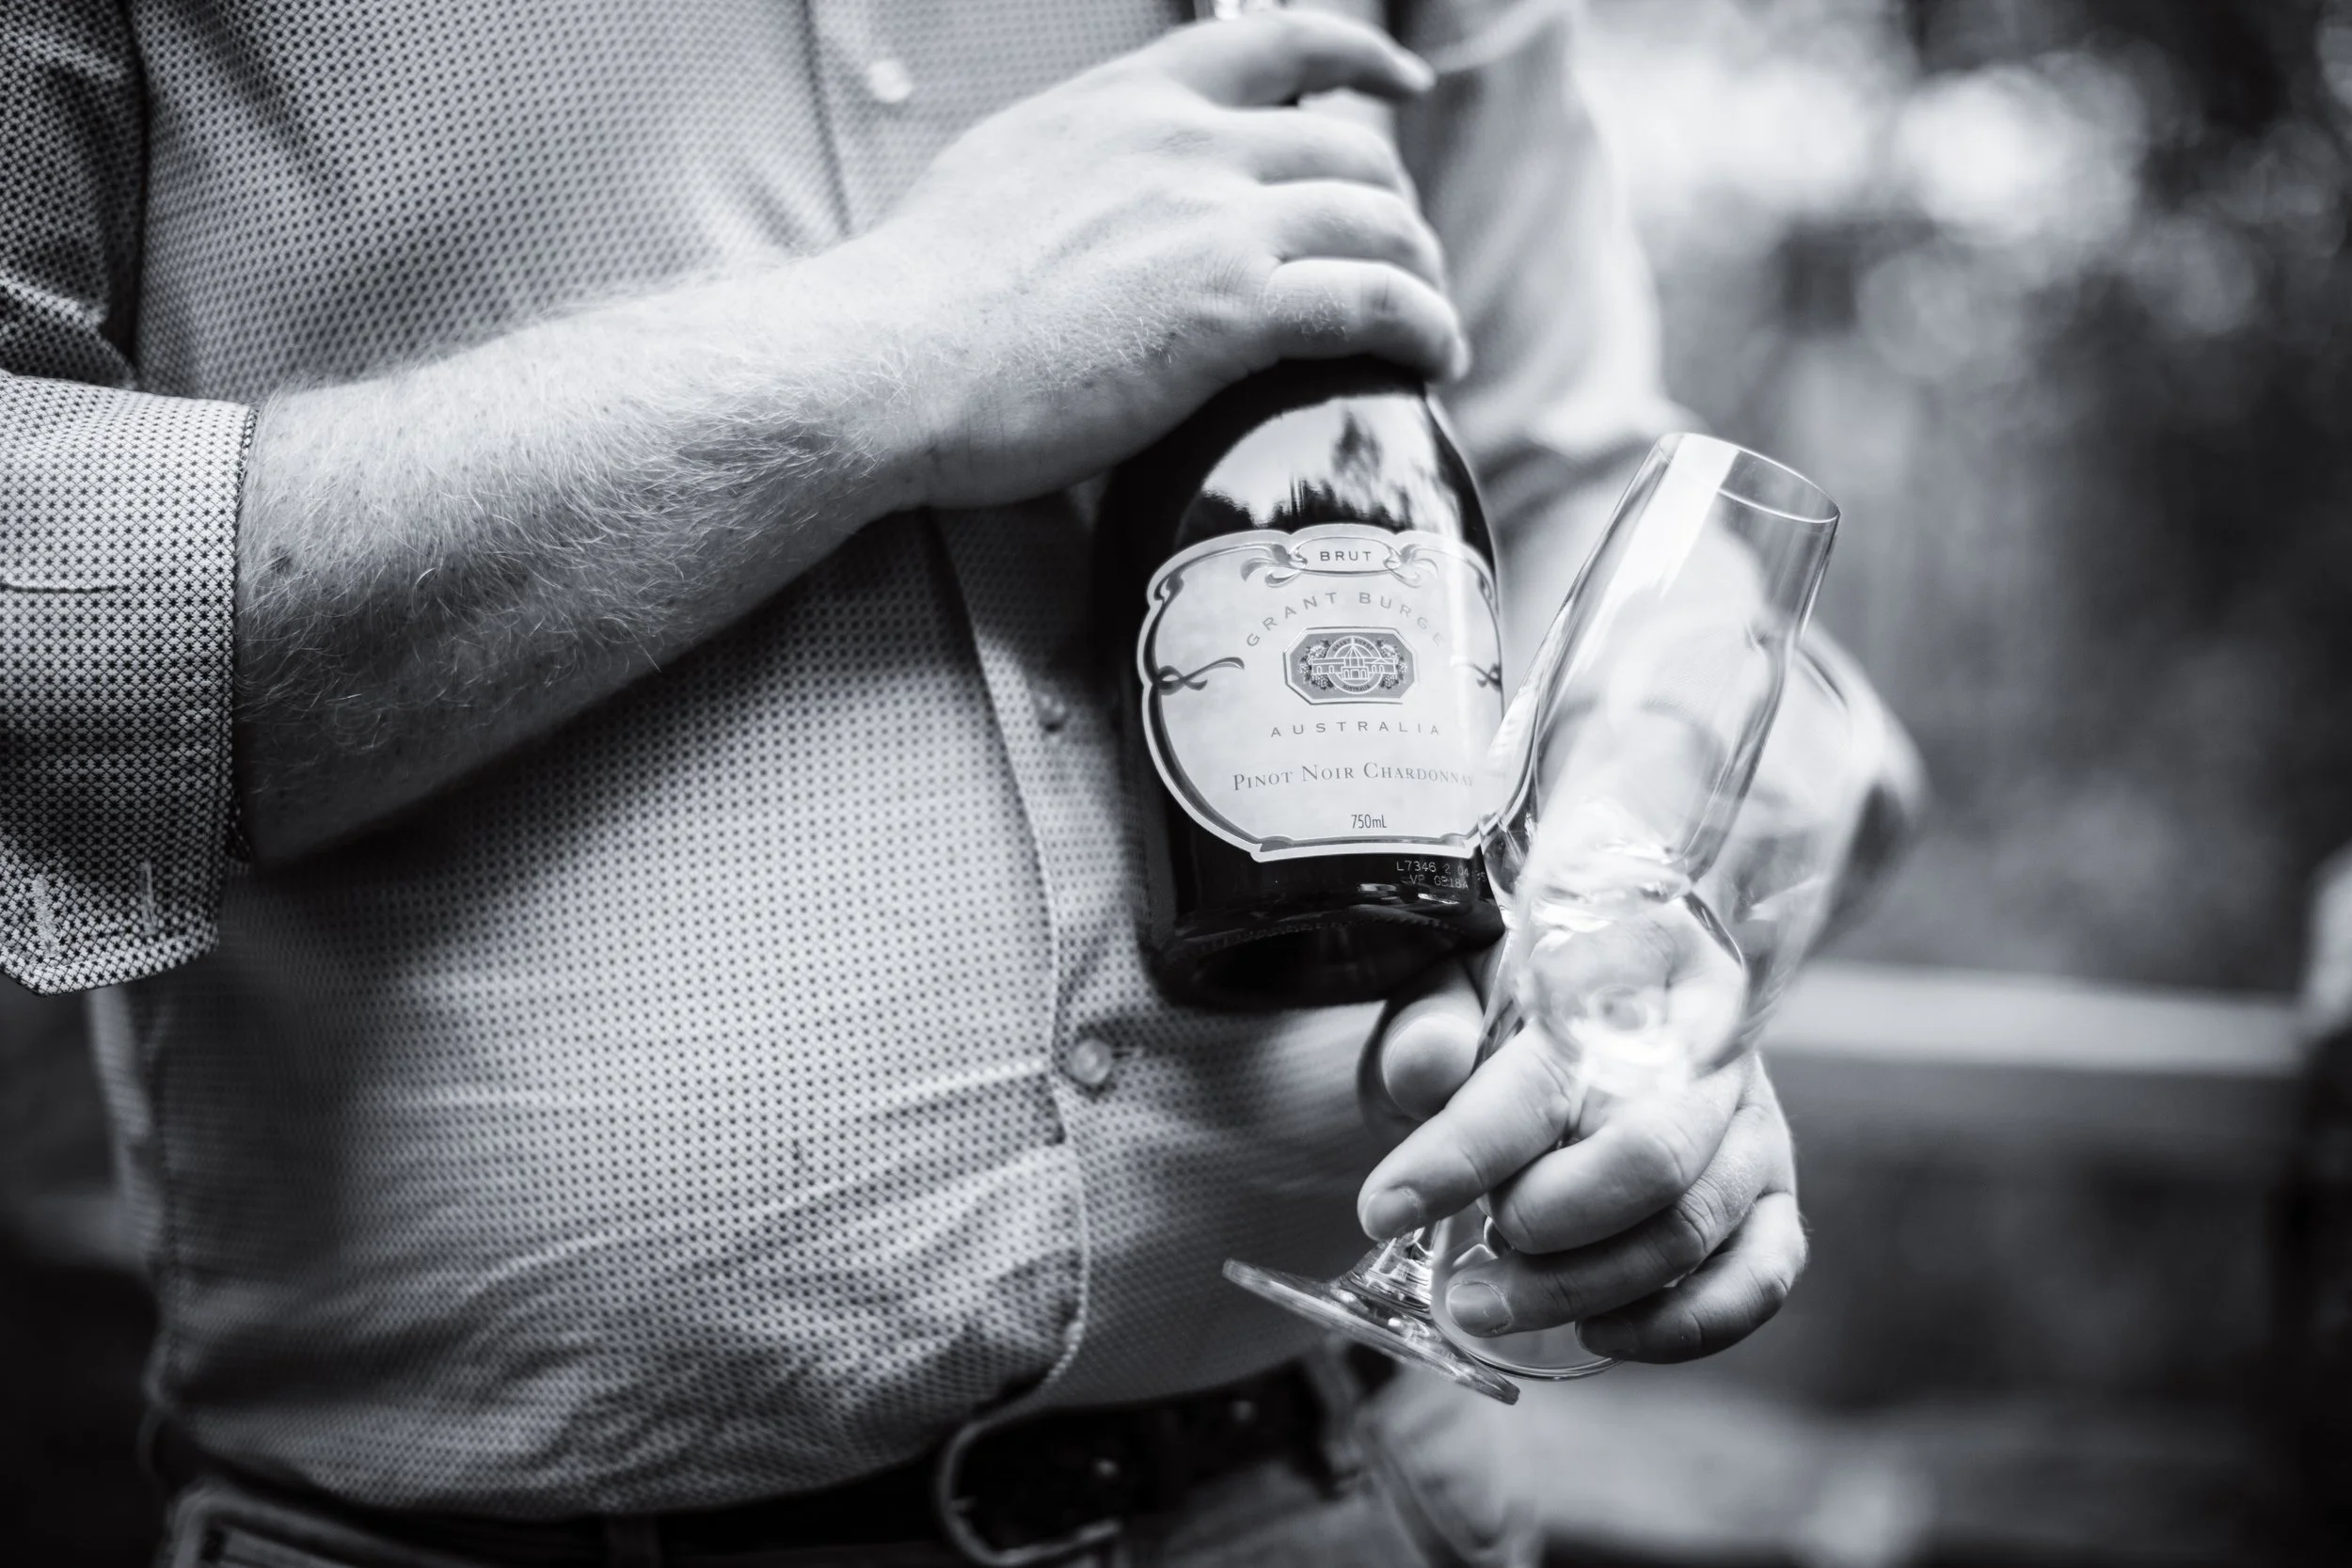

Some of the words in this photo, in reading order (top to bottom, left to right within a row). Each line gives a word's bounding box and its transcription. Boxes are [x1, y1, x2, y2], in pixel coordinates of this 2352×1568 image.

[1320, 550, 1372, 562] BRUT
[1246, 592, 1337, 647] GRANT
[1359, 592, 1444, 648] BURGE
[1270, 721, 1439, 737] AUSTRALIA
[1302, 764, 1355, 782] NOIR
[1351, 814, 1387, 829] 750mL
[1396, 860, 1437, 873] L7346
